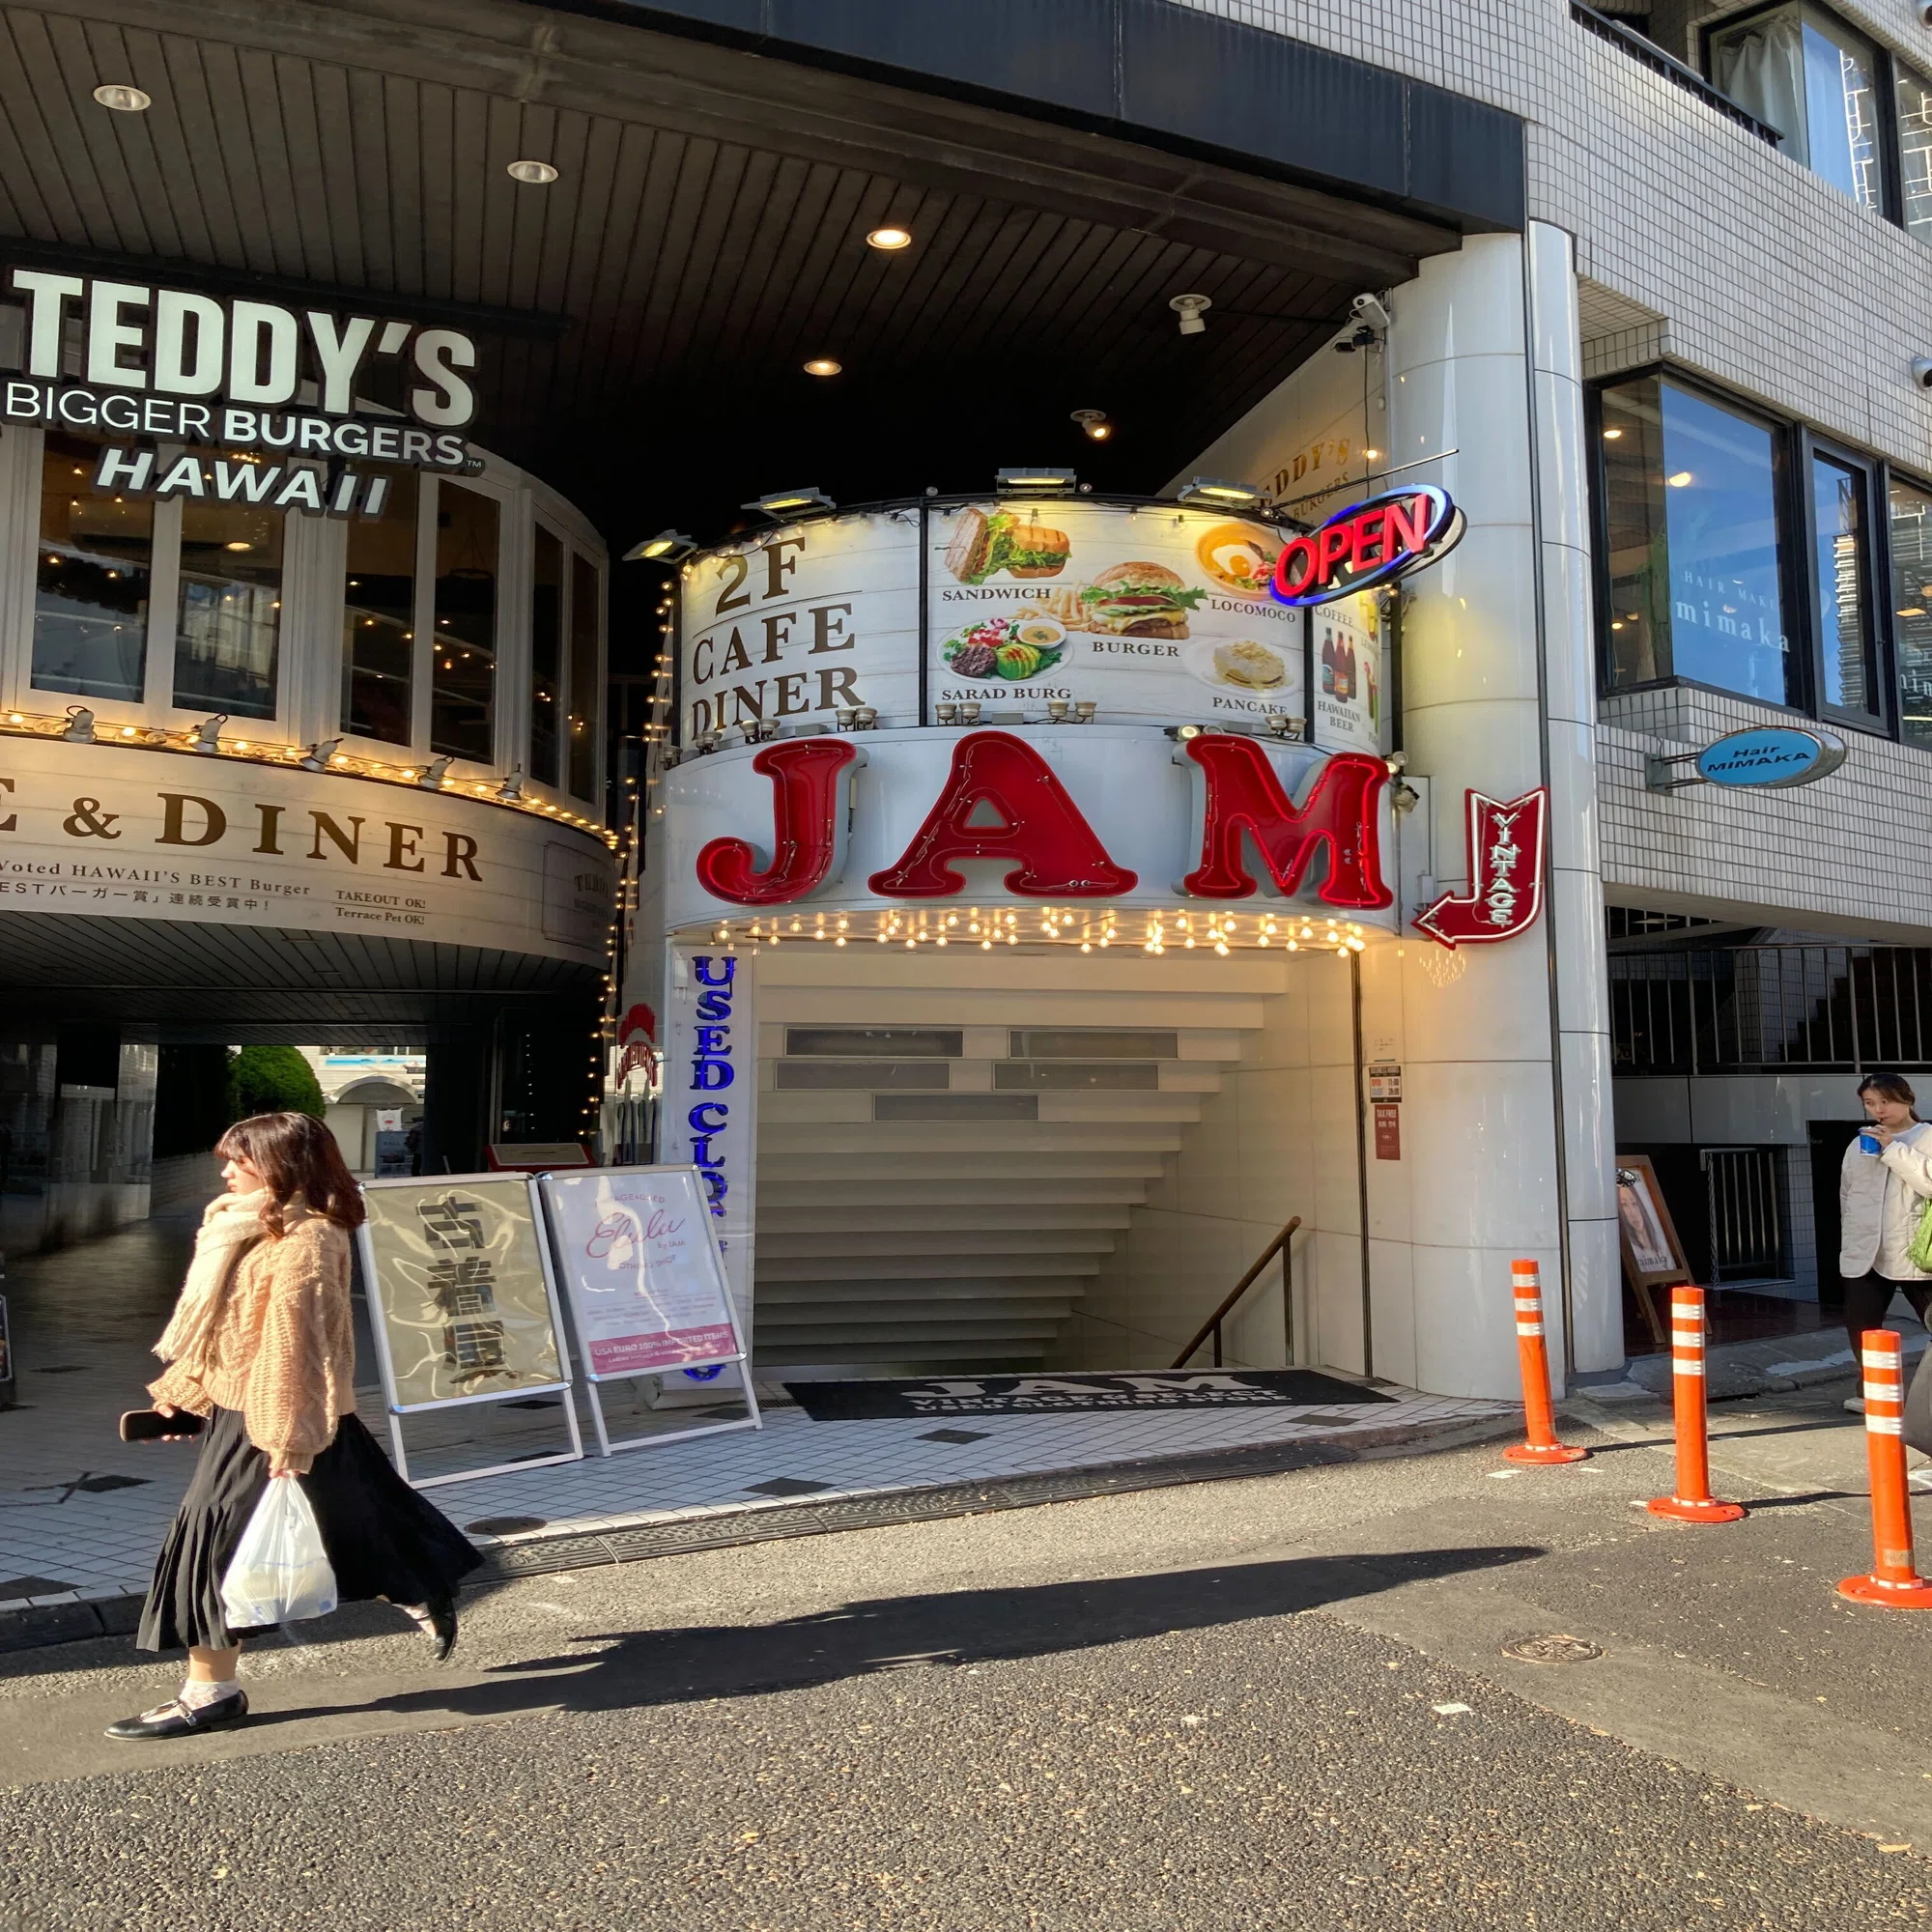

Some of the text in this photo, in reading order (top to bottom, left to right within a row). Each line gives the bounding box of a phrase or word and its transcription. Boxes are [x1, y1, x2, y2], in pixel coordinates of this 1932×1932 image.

[13, 269, 476, 426] TEDDY'S
[6, 382, 210, 438] BIGGER
[224, 409, 465, 466] BURGERS
[97, 448, 386, 514] HAWAII
[1273, 493, 1432, 599] OPEN
[716, 536, 806, 617] 2F
[1684, 570, 1726, 595] HAIR
[942, 587, 1052, 602] SANDWICH
[1210, 598, 1296, 623] LOCOMOCO
[1314, 605, 1354, 628] COFFEE
[1675, 600, 1791, 653] mimaka
[693, 603, 856, 685] CAFE
[1092, 640, 1179, 657] BURGER
[691, 667, 867, 741] DINER
[941, 687, 1072, 701] SARAD BURG
[1211, 696, 1288, 716] PANCAKE
[1317, 699, 1361, 723] HAWAIIAN
[1329, 716, 1354, 733] BEER
[1706, 751, 1812, 773] MIMAKA
[1732, 745, 1781, 758] Hair
[696, 730, 1394, 911] JAM
[63, 797, 123, 839] &
[154, 791, 484, 882] DINER
[71, 864, 181, 884] HAWAII'S
[189, 873, 242, 889] BEST
[249, 878, 310, 896] Burger
[1485, 811, 1522, 928] VINTAGE
[335, 889, 426, 909] TAKEOUT OK!
[334, 906, 425, 925] Terrace Pet OK!
[690, 954, 738, 1091] USED
[594, 1347, 613, 1357] USA
[613, 1343, 638, 1354] EURO
[639, 1341, 662, 1351] 100%
[662, 1335, 703, 1348] IMPORTED
[703, 1330, 728, 1342] ITEMS
[899, 1375, 1263, 1399] JAM
[908, 1394, 1094, 1406] VINTAGE
[1134, 1389, 1279, 1401] SELECT
[914, 1394, 1293, 1412] USED CLOTHING STORE
